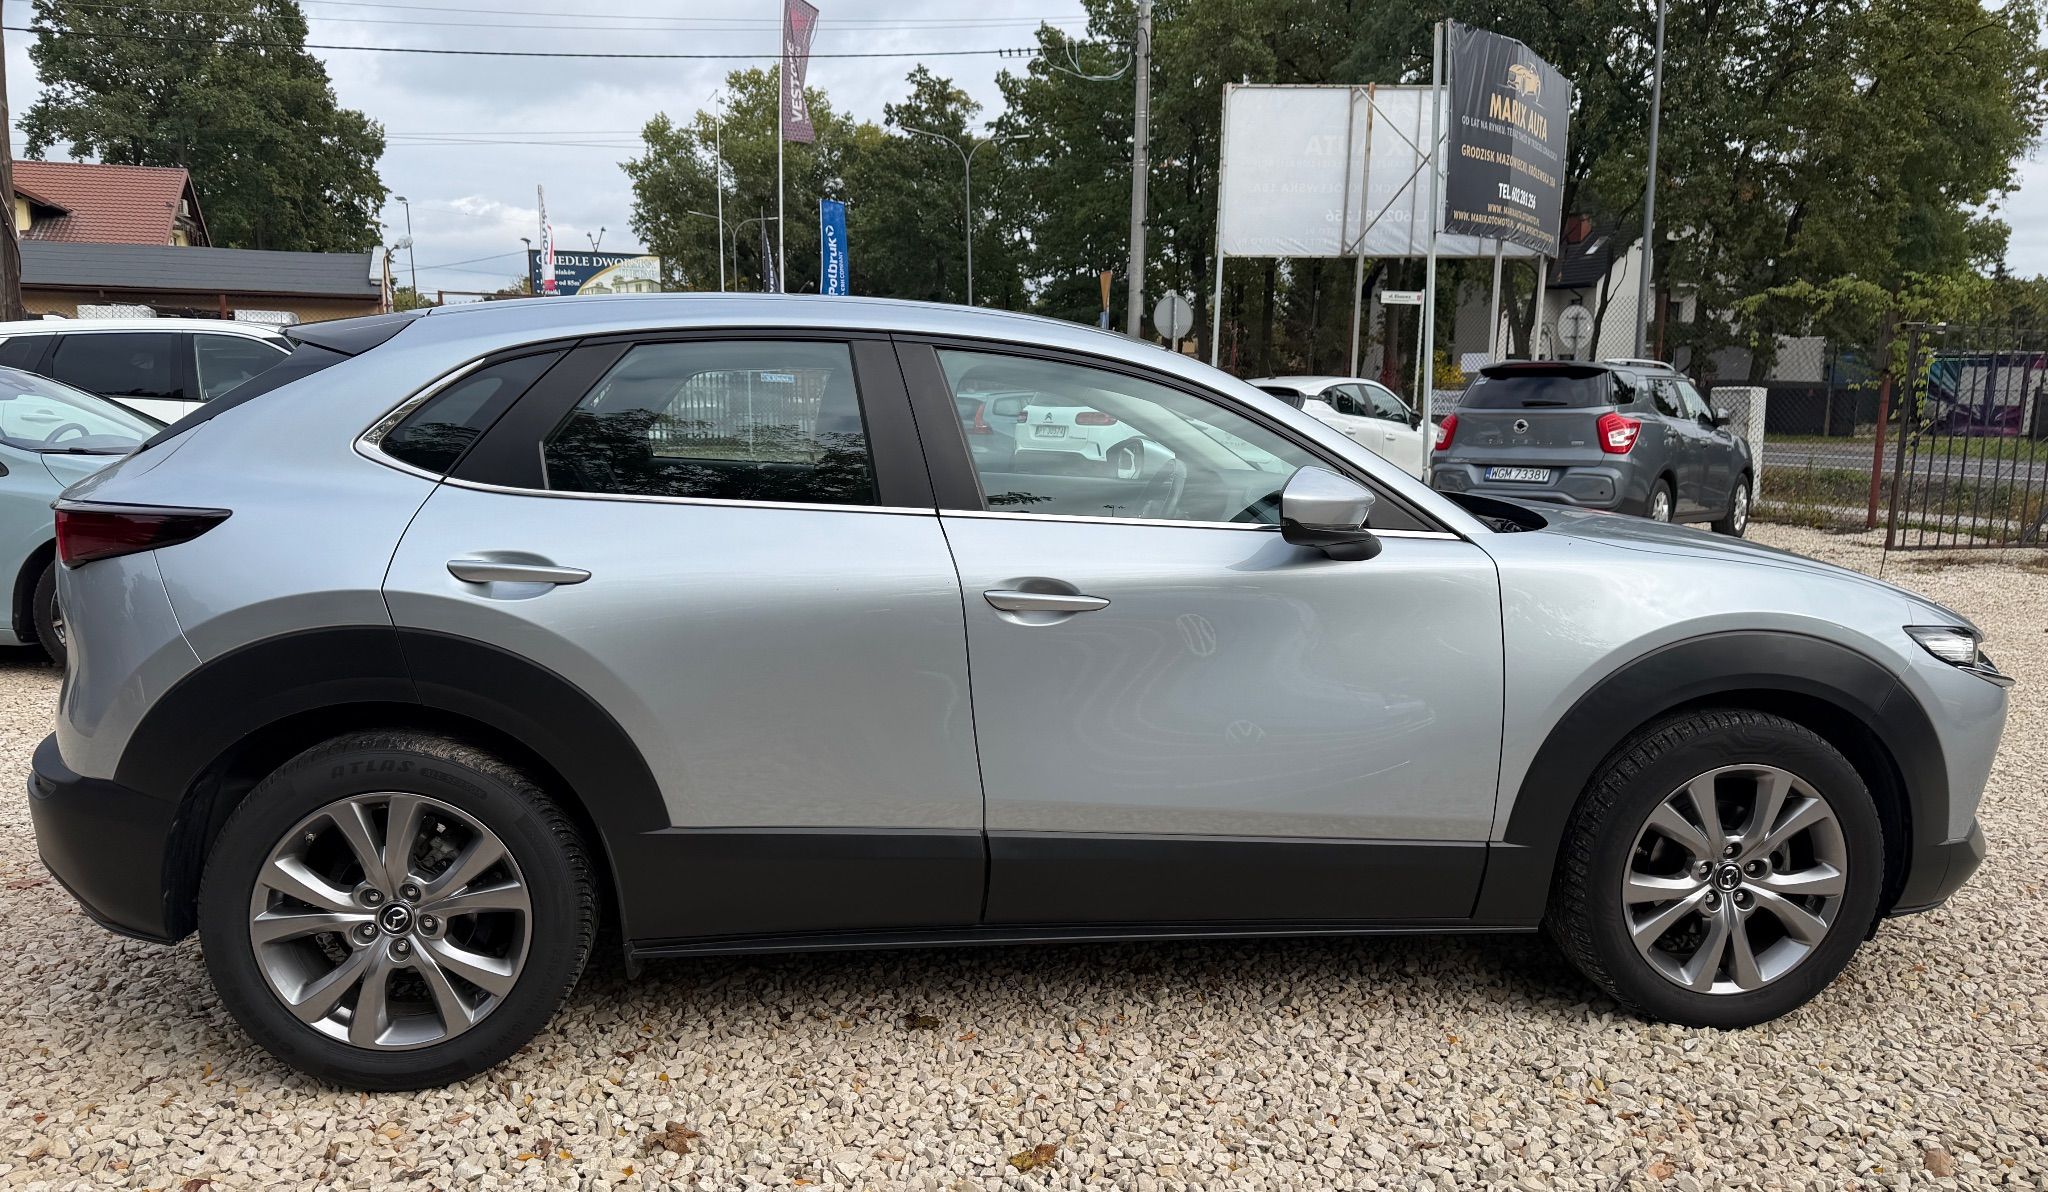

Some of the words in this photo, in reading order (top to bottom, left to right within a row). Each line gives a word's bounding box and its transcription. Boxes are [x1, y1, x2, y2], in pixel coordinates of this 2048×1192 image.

[1489, 93, 1527, 129] MARIX
[1528, 109, 1547, 142] AUTA
[1461, 144, 1495, 161] GRODZISK
[1511, 186, 1520, 203] 602
[1492, 468, 1512, 480] WGM
[1514, 468, 1548, 480] 7338V
[331, 760, 415, 779] ATLAS
